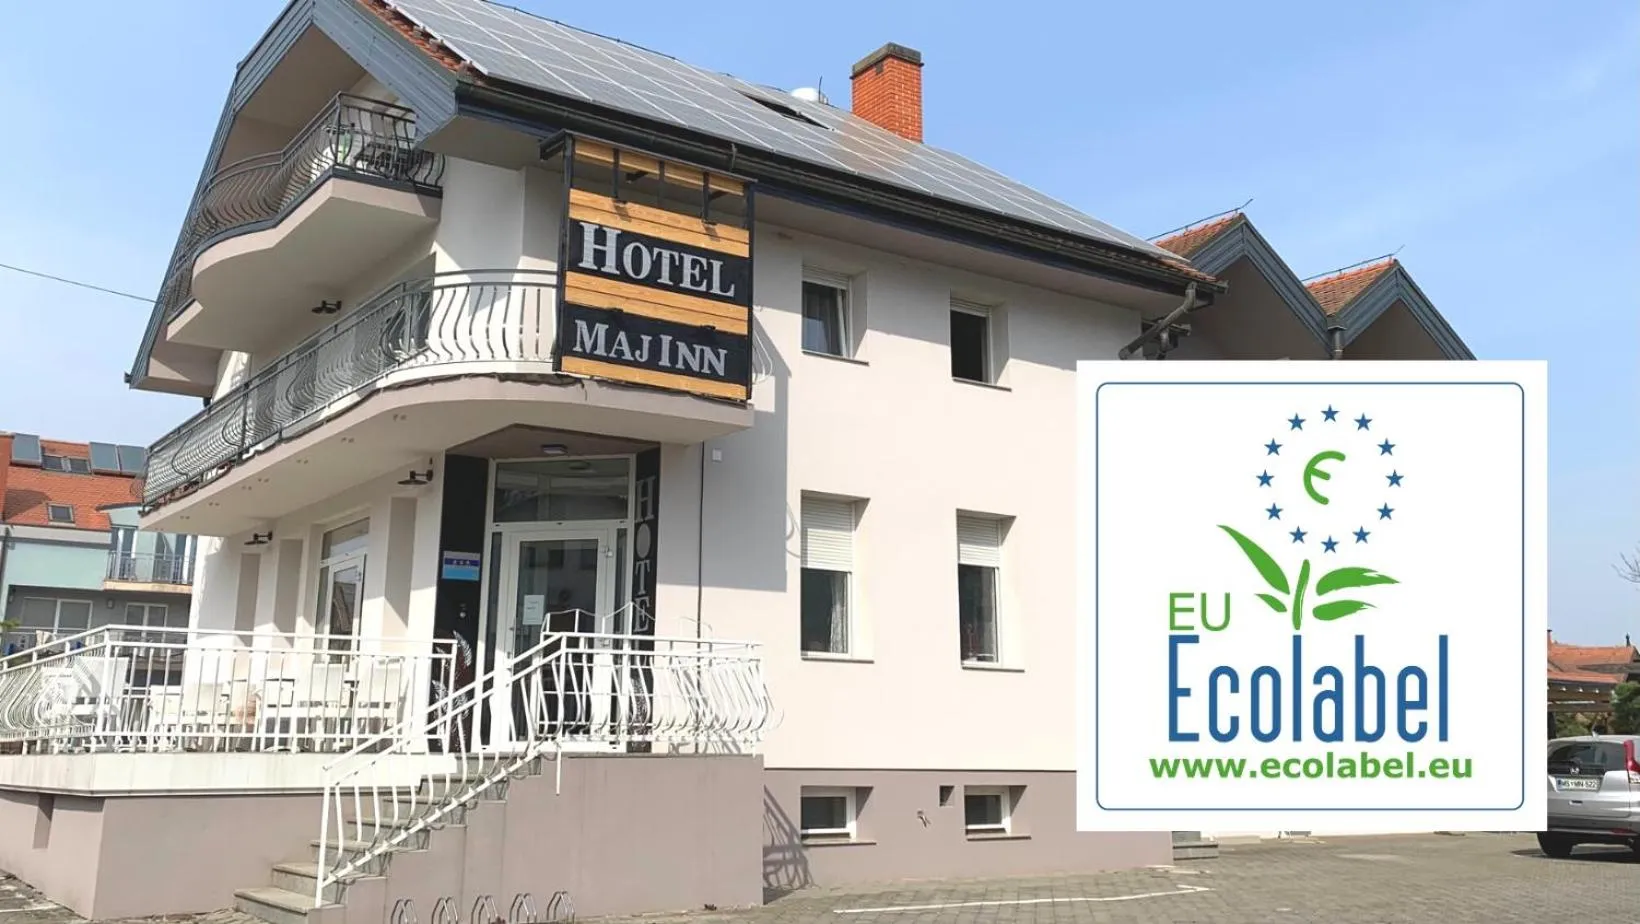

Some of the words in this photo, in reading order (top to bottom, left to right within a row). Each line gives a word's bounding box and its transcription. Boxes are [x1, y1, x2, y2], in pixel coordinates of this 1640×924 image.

[578, 222, 735, 297] HOTEL
[573, 320, 652, 363] MAJ
[659, 334, 727, 376] INN
